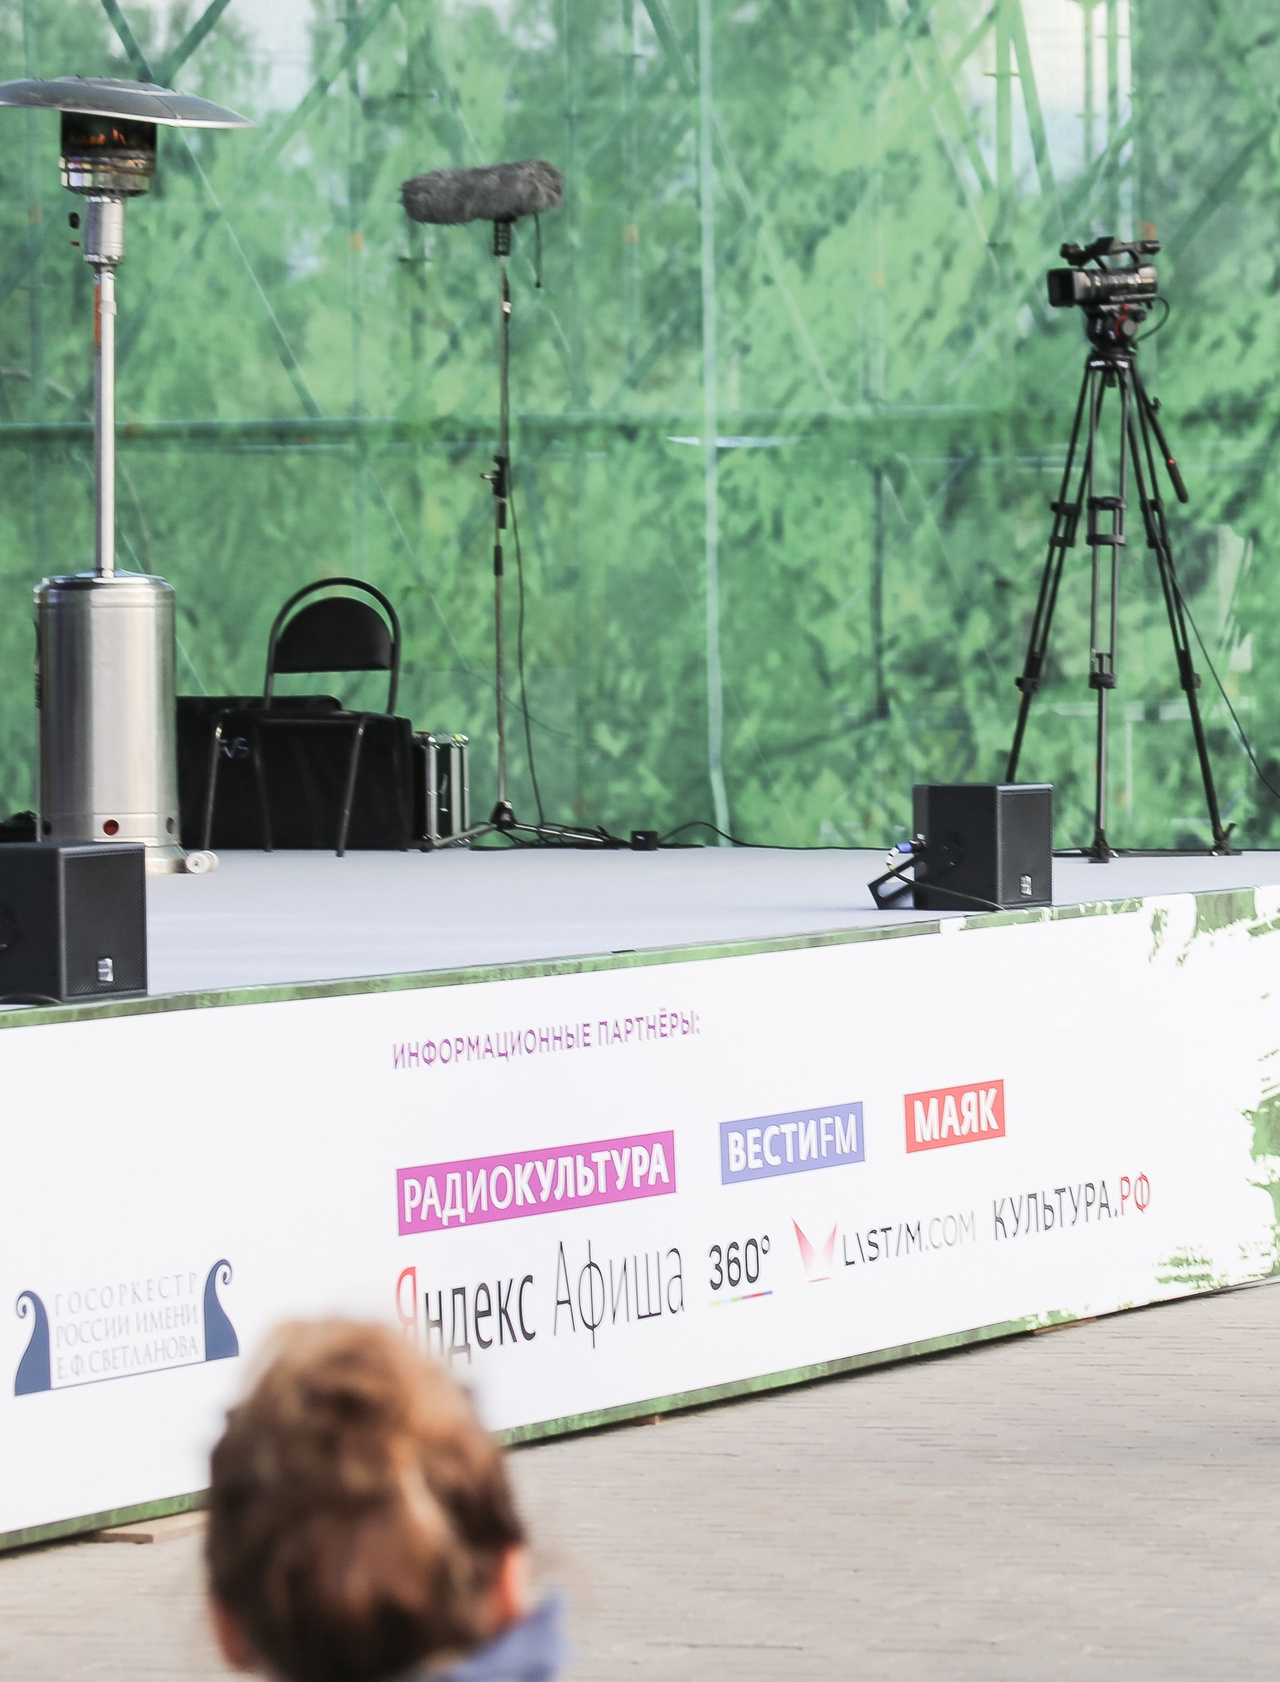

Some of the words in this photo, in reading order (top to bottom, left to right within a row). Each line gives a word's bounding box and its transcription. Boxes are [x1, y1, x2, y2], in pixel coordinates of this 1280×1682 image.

[392, 1022, 592, 1070] ИНФОРМАЦИОННЫЕ
[598, 1007, 701, 1046] ПАРТНЁРЫ:
[913, 1087, 1000, 1144] МАЯК
[403, 1142, 671, 1227] РАДИОКУЛЬТУРА
[992, 1171, 1151, 1241] КУЛЬТУРА.РФ
[54, 1272, 198, 1317] ГОСОРКЕСТР
[394, 1266, 537, 1366] Яндекс
[553, 1239, 685, 1349] Афиша
[55, 1314, 131, 1349] РОССИИ
[135, 1303, 199, 1334] ИМЕНИ
[88, 1334, 200, 1374] СВЕТЛАНОВА
